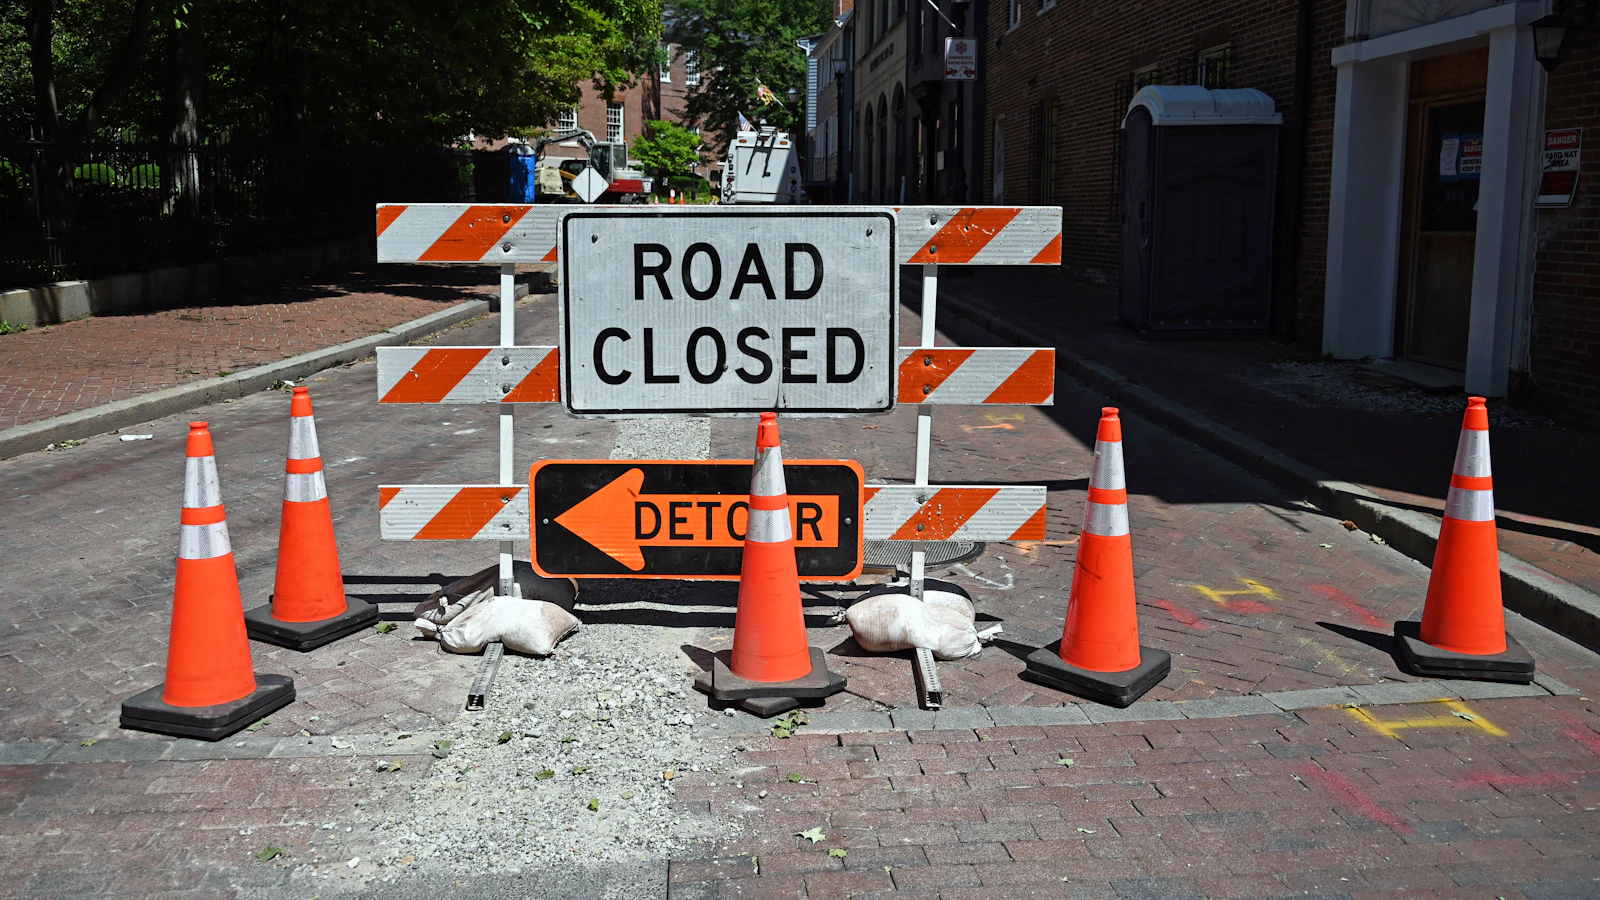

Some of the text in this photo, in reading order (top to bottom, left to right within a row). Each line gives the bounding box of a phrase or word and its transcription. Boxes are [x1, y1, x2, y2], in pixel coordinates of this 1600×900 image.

[1463, 145, 1482, 153] DANGE
[1547, 135, 1577, 146] DANGER
[1545, 150, 1578, 160] HARD HAT
[634, 242, 823, 300] ROAD
[594, 326, 865, 384] CLOSED
[635, 501, 823, 540] DETOR
